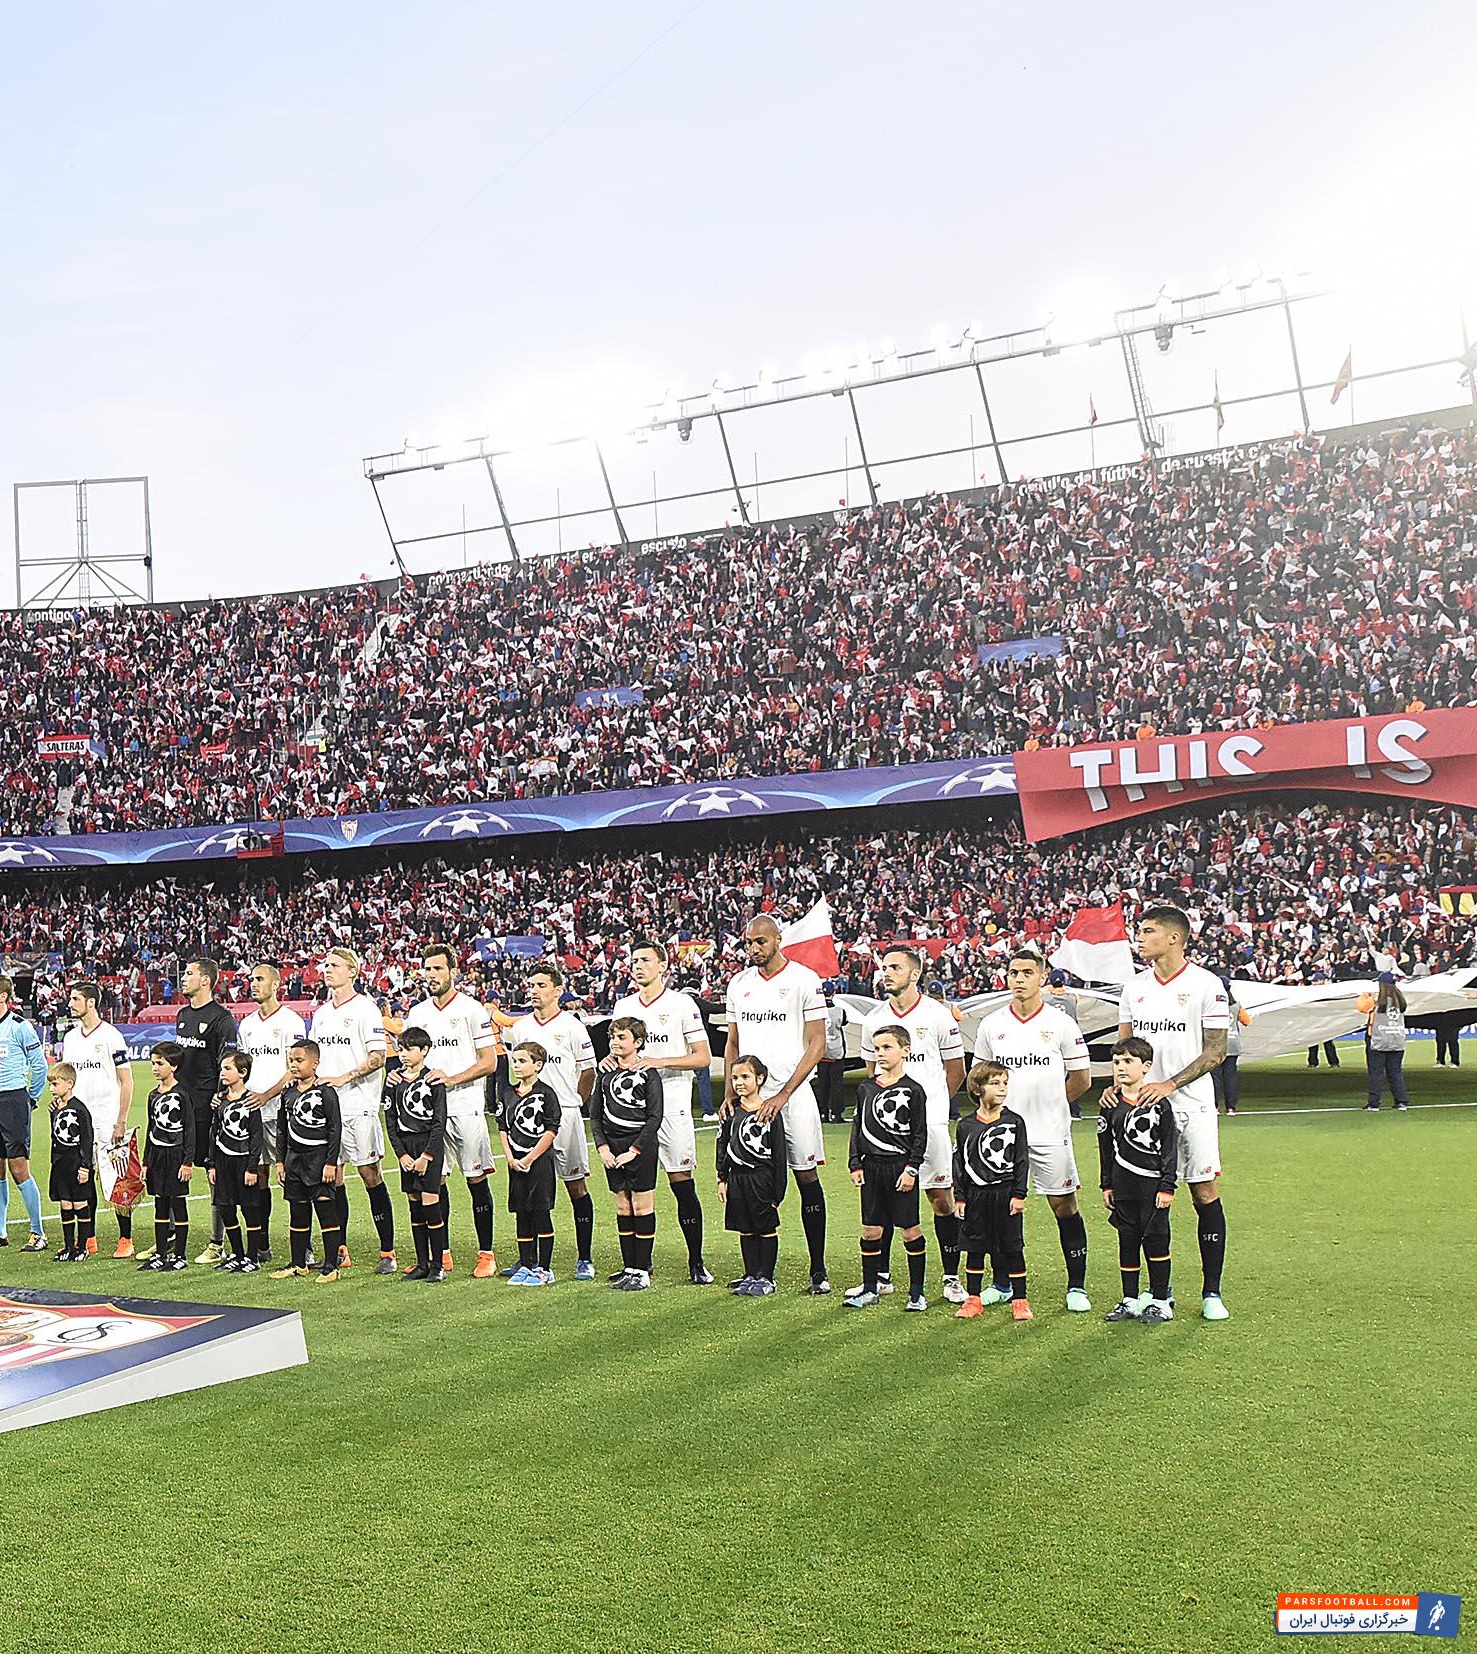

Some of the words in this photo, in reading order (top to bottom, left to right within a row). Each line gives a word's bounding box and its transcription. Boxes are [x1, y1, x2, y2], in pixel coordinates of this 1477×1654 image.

[1100, 464, 1145, 483] fútbo
[32, 609, 72, 624] ontigo
[46, 741, 85, 752] SALTERAS
[1070, 735, 1268, 812] THIS
[1346, 719, 1433, 784] IS
[741, 1010, 787, 1024] Playtika
[1133, 1018, 1186, 1034] Playtika
[1202, 1232, 1218, 1243] SFC
